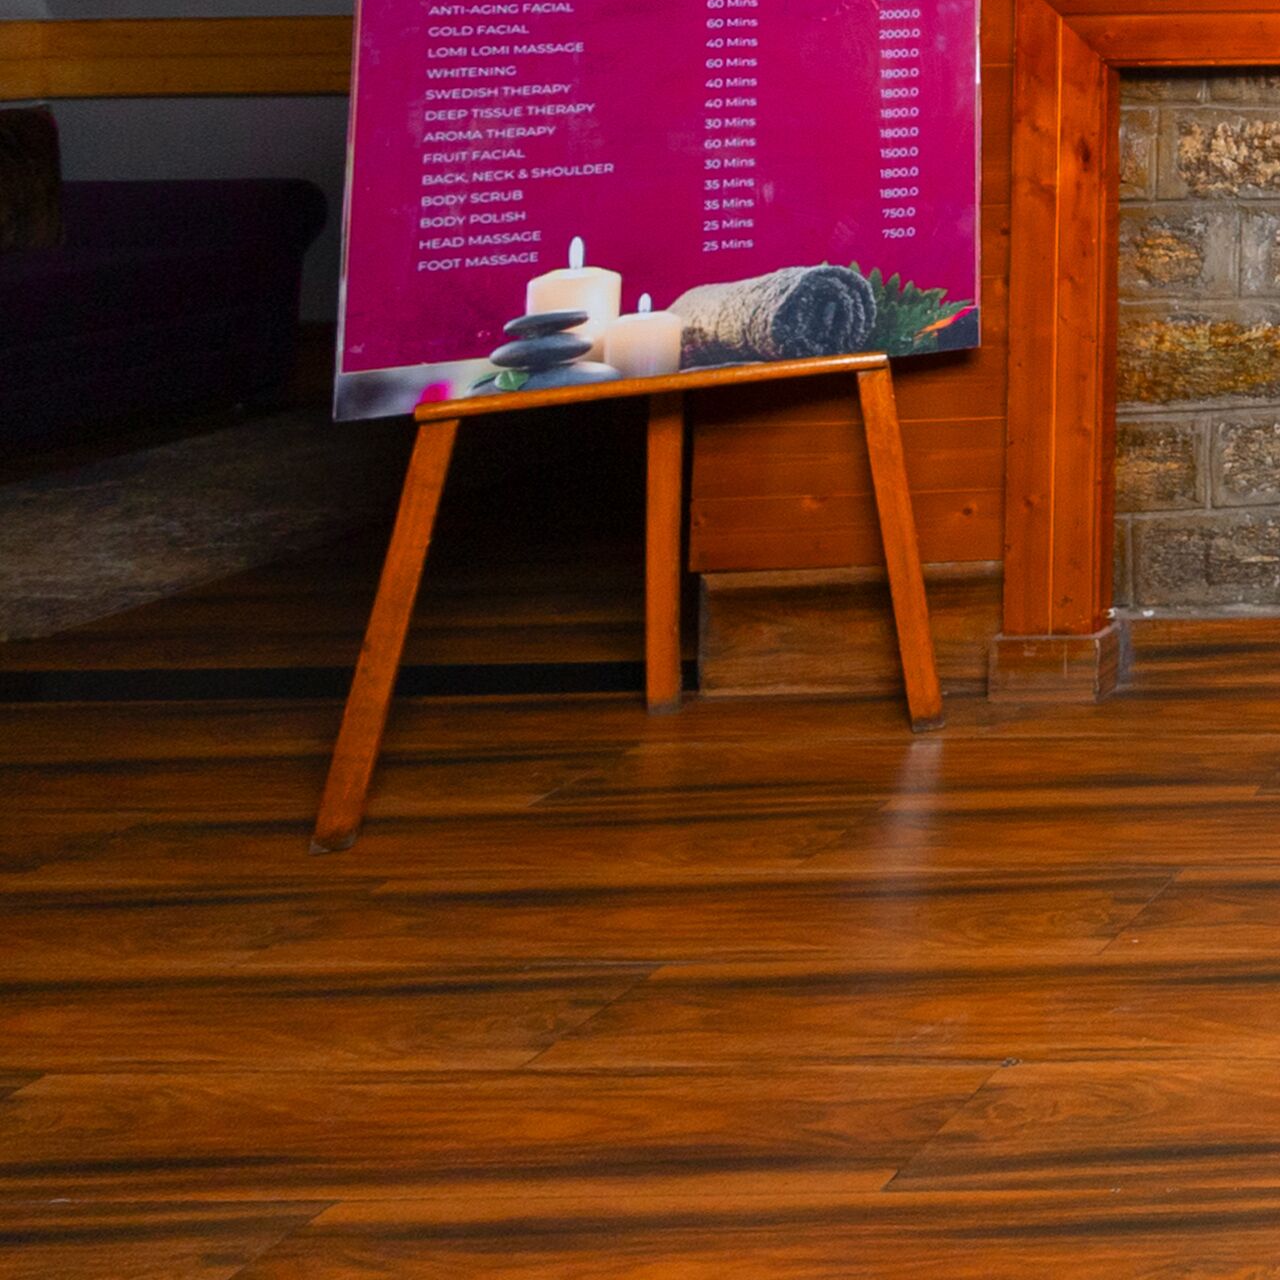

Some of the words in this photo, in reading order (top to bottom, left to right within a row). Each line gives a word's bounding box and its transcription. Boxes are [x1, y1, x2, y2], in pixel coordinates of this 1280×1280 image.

[429, 4, 519, 15] ANTI-AGING
[523, 3, 573, 13] FACIAL
[707, 0, 724, 8] 60
[879, 9, 921, 20] 2000.0
[706, 19, 724, 28] 60
[727, 18, 758, 27] Mins
[428, 26, 473, 37] GOLD
[477, 25, 529, 35] FACIAL
[879, 28, 920, 39] 2000.0
[706, 38, 724, 48] 40
[727, 38, 758, 47] Mins
[428, 47, 467, 58] LOMI
[471, 46, 509, 56] LOMI
[513, 42, 584, 54] MASSAGE
[880, 48, 919, 59] 1800.0
[706, 58, 723, 68] 60
[726, 58, 757, 67] Mins
[427, 66, 516, 79] WHITENING
[880, 68, 919, 79] 1800.0
[705, 78, 723, 88] 40
[726, 78, 757, 87] Mins
[426, 88, 498, 100] SWEDISH
[502, 84, 571, 95] THERAPY
[880, 87, 919, 98] 1800.0
[705, 98, 722, 108] 40
[725, 97, 757, 106] Mins
[425, 110, 468, 121] DEEP
[472, 107, 522, 118] TISSUE
[528, 103, 595, 115] THERAPY
[880, 107, 919, 119] 1800.0
[705, 118, 722, 129] 30
[725, 118, 756, 127] Mins
[423, 130, 482, 142] AROMA
[487, 126, 556, 138] THERAPY
[880, 127, 919, 138] 1800.0
[704, 139, 722, 149] 60
[725, 138, 756, 147] Mins
[423, 151, 468, 164] FRUIT
[472, 149, 525, 160] FACIAL
[880, 146, 919, 158] 1500.0
[704, 159, 721, 169] 30
[724, 158, 756, 167] Mins
[473, 170, 514, 181] NECK
[518, 169, 528, 179] &
[531, 163, 614, 178] SHOULDER
[880, 166, 919, 179] 1800.0
[705, 179, 720, 190] 35
[723, 178, 754, 188] Mins
[421, 195, 466, 207] BODY
[471, 190, 523, 203] SCRUB
[880, 187, 919, 198] 1800.0
[704, 199, 720, 210] 35
[723, 198, 754, 208] Mins
[882, 207, 916, 218] 750.0
[420, 216, 465, 228] BODY
[470, 211, 526, 223] POLISH
[704, 220, 719, 231] 25
[722, 219, 754, 228] Mins
[882, 227, 915, 238] 750.0
[419, 237, 465, 249] HEAD
[468, 231, 541, 245] MASSAGE
[703, 241, 719, 251] 25
[721, 239, 753, 249] Mins
[418, 258, 461, 271] FOOT
[465, 252, 538, 267] MASSAGE
